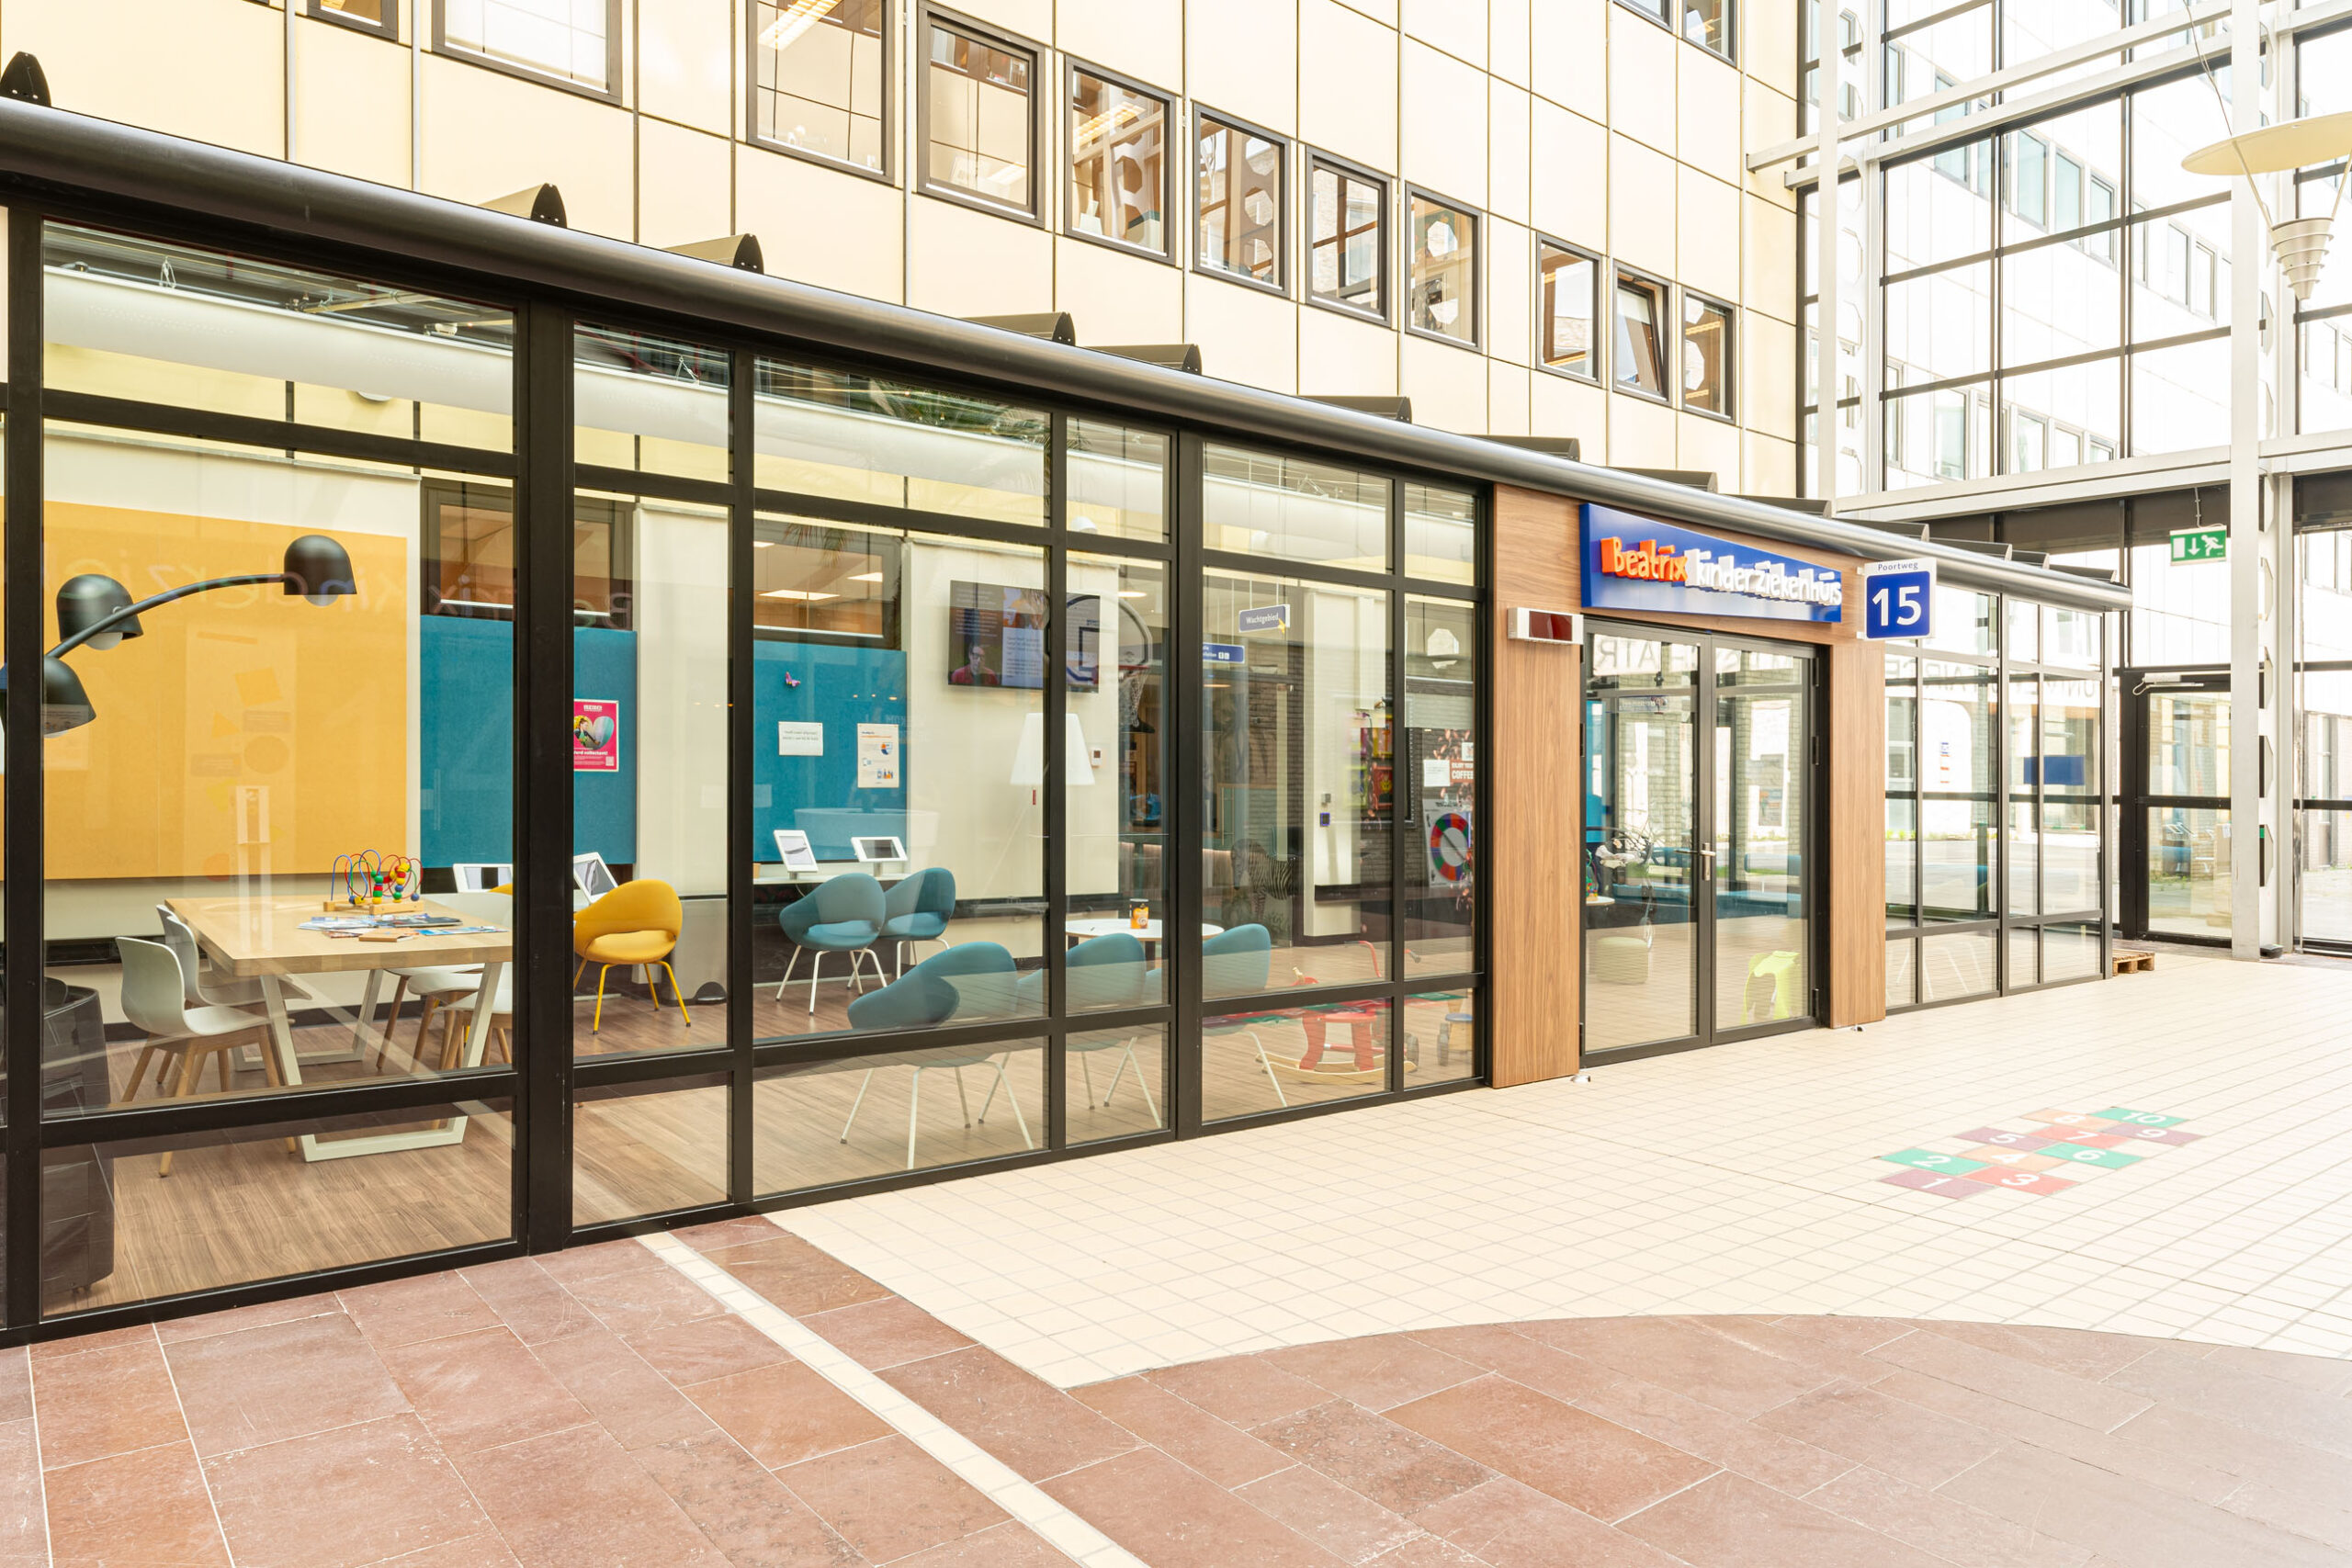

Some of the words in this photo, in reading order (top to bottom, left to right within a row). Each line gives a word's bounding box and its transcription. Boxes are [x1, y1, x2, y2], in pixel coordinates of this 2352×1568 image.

[1600, 536, 1689, 581] Beatrix
[1685, 548, 1842, 606] kinderziekenhuis
[1878, 562, 1918, 571] Poortweg
[1871, 585, 1922, 626] 15
[1245, 612, 1279, 625] Wachtgebied
[2053, 1114, 2086, 1124] 8
[2122, 1111, 2166, 1123] 10
[1989, 1133, 2026, 1144] 5
[2065, 1131, 2099, 1141] 7
[2136, 1128, 2167, 1138] 9
[1991, 1153, 2027, 1164] 4
[2072, 1149, 2108, 1161] 6
[1912, 1155, 1952, 1168] 2
[1921, 1178, 1953, 1190] 1
[2001, 1174, 2040, 1186] 3
